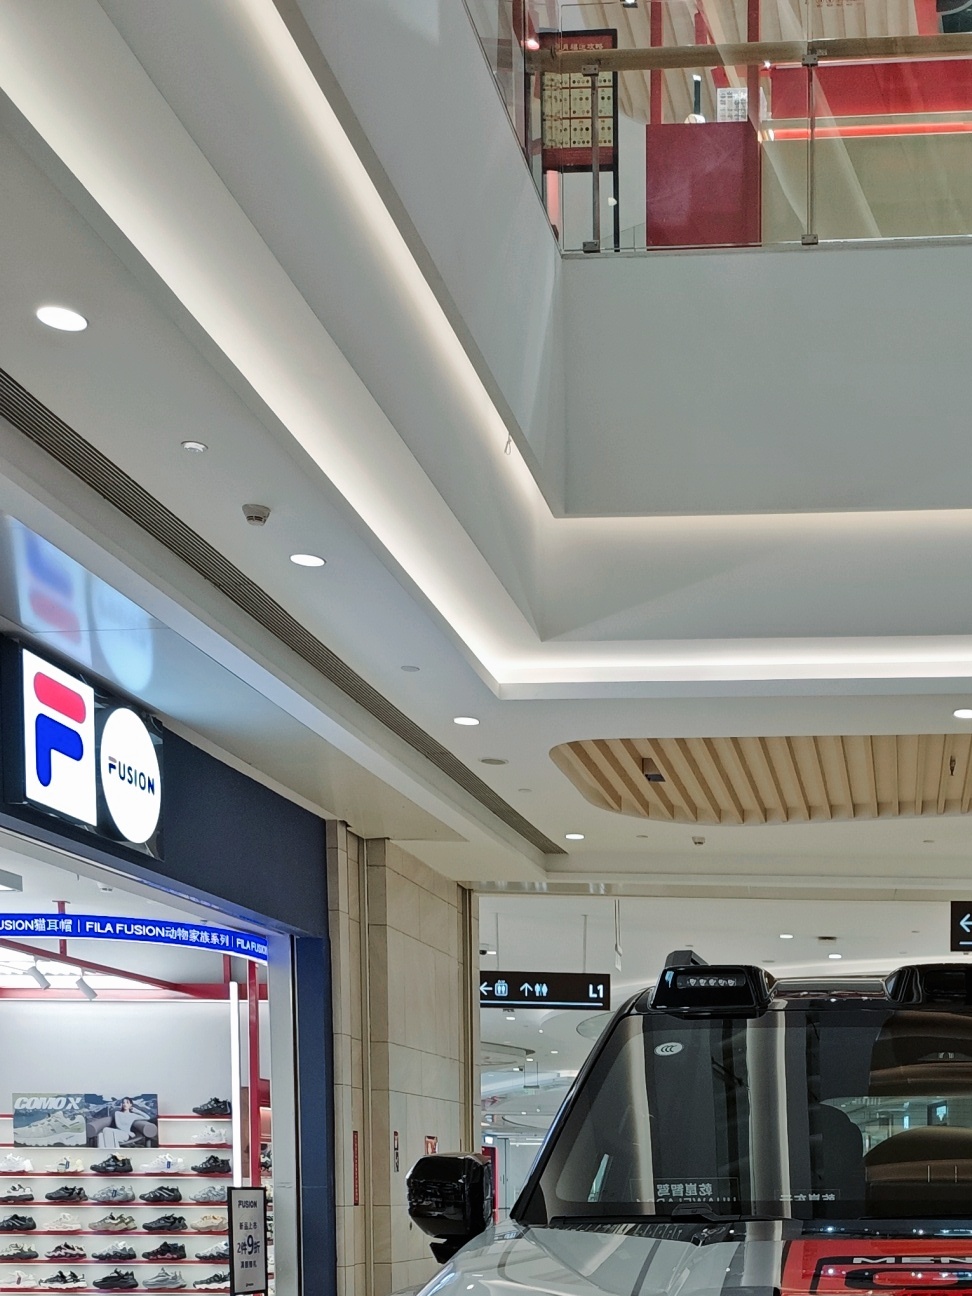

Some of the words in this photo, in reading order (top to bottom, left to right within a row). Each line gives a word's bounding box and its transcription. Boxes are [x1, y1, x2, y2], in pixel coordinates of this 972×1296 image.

[108, 755, 155, 796] FUSION
[85, 921, 114, 934] FILA
[588, 983, 604, 998] L1
[237, 1200, 258, 1209] FUSION
